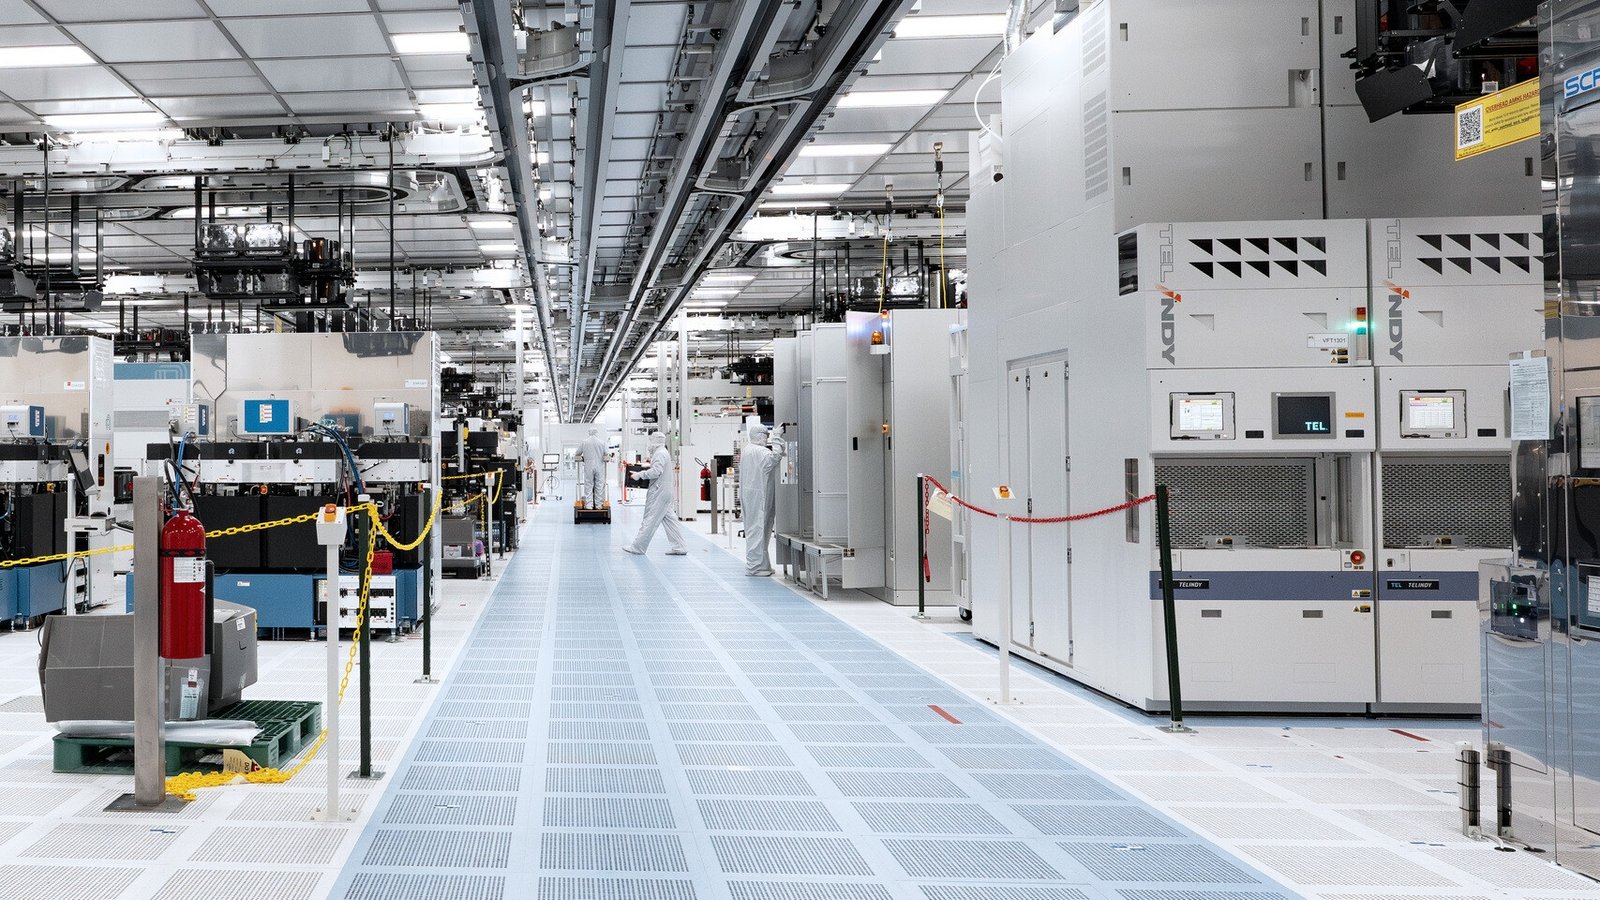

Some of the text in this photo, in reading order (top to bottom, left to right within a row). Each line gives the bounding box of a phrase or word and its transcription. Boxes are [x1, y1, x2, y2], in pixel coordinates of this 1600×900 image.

[1160, 223, 1173, 283] TEL
[1387, 219, 1401, 279] TEL
[1305, 422, 1326, 430] TEL
